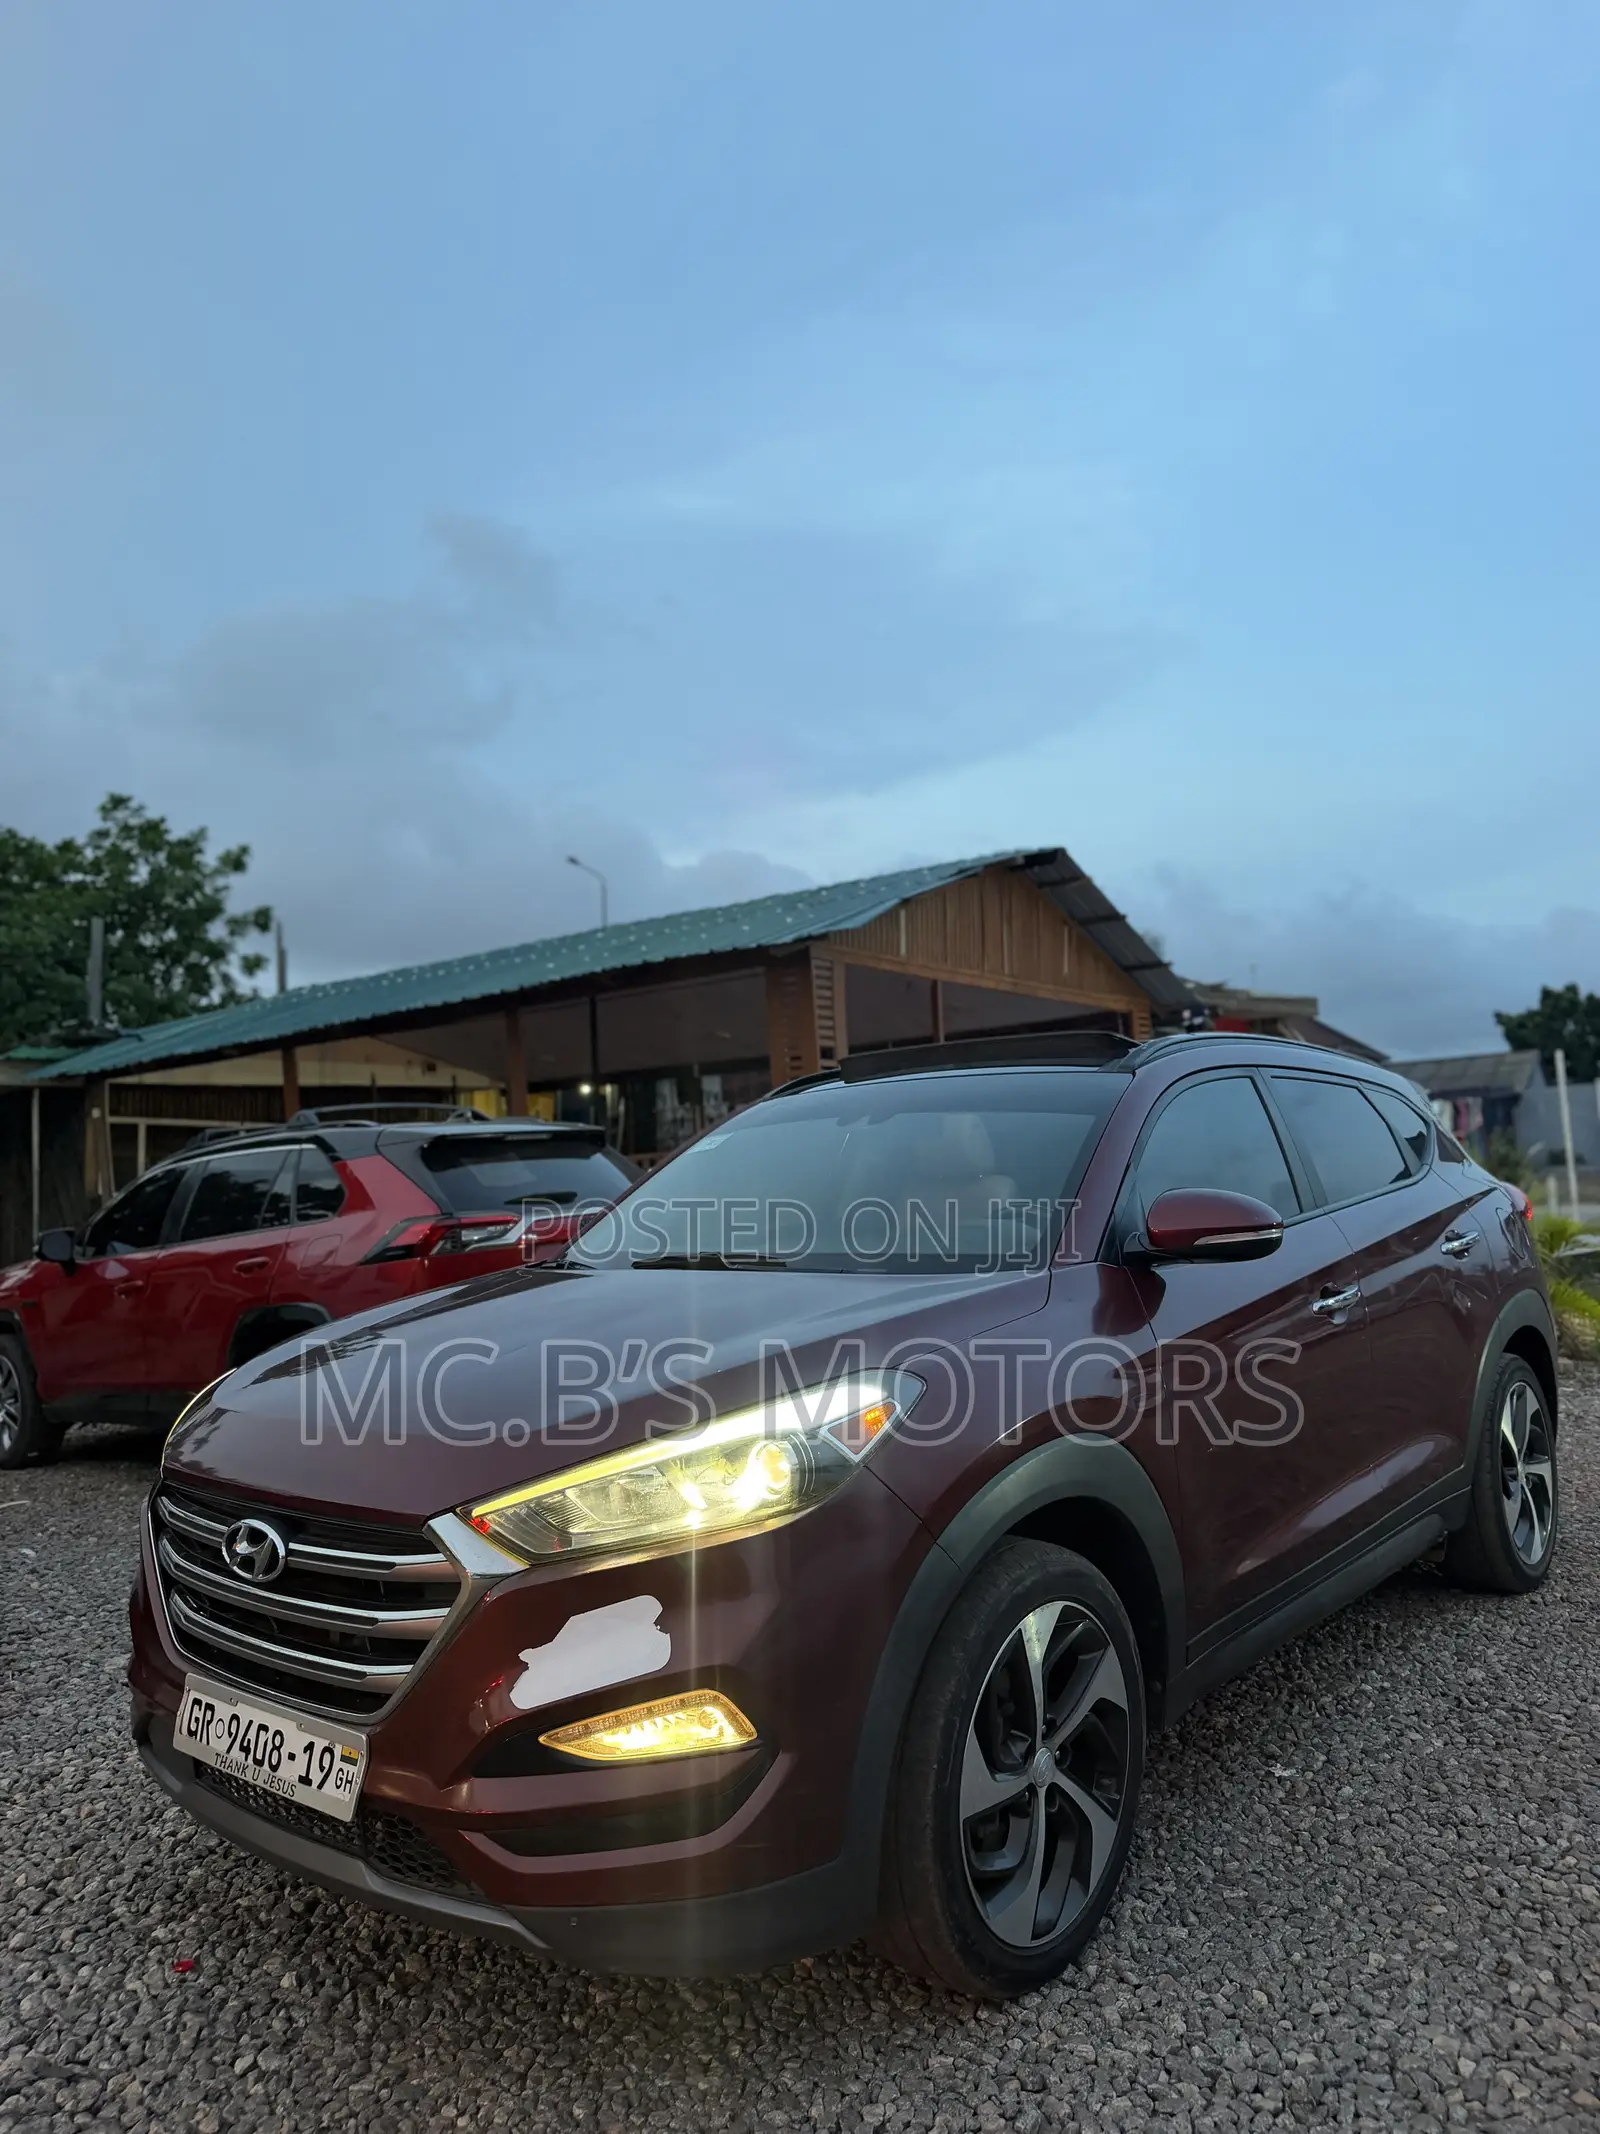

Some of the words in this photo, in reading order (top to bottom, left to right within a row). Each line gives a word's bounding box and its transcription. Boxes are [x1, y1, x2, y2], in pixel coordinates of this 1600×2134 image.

[214, 1752, 248, 1778] THANK
[252, 1769, 261, 1781] U
[263, 1775, 297, 1798] JESUS
[335, 1767, 355, 1795] GH
